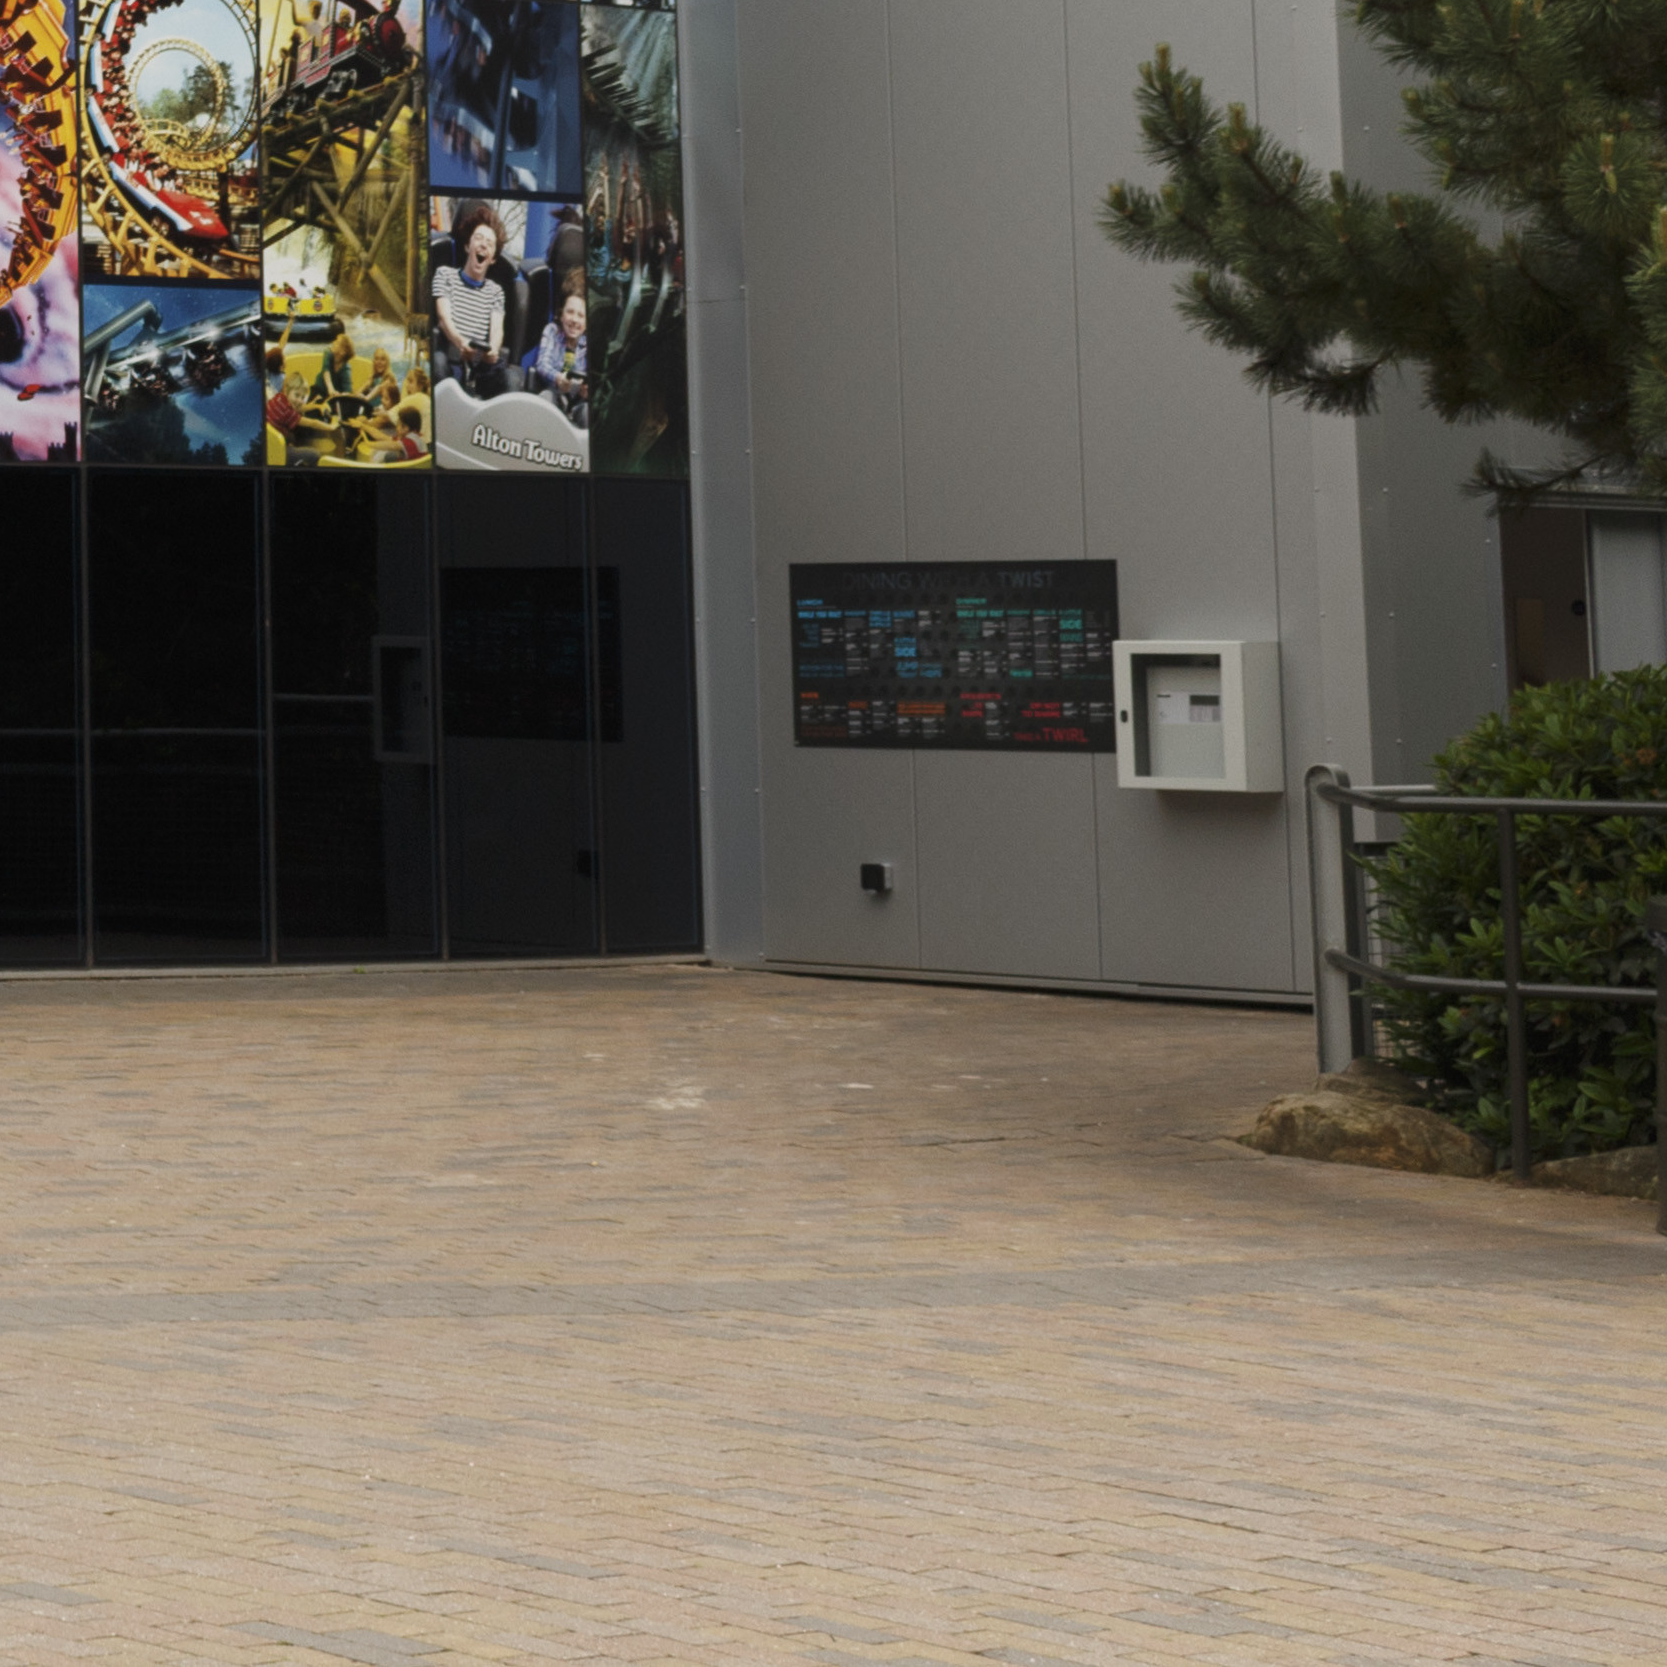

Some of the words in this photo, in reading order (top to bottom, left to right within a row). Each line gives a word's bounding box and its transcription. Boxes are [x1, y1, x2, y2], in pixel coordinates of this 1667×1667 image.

[471, 422, 522, 458] Alton
[523, 439, 583, 470] Towers
[842, 571, 912, 590] DINING
[997, 570, 1055, 589] TWIST
[1042, 726, 1090, 743] TWIRL
